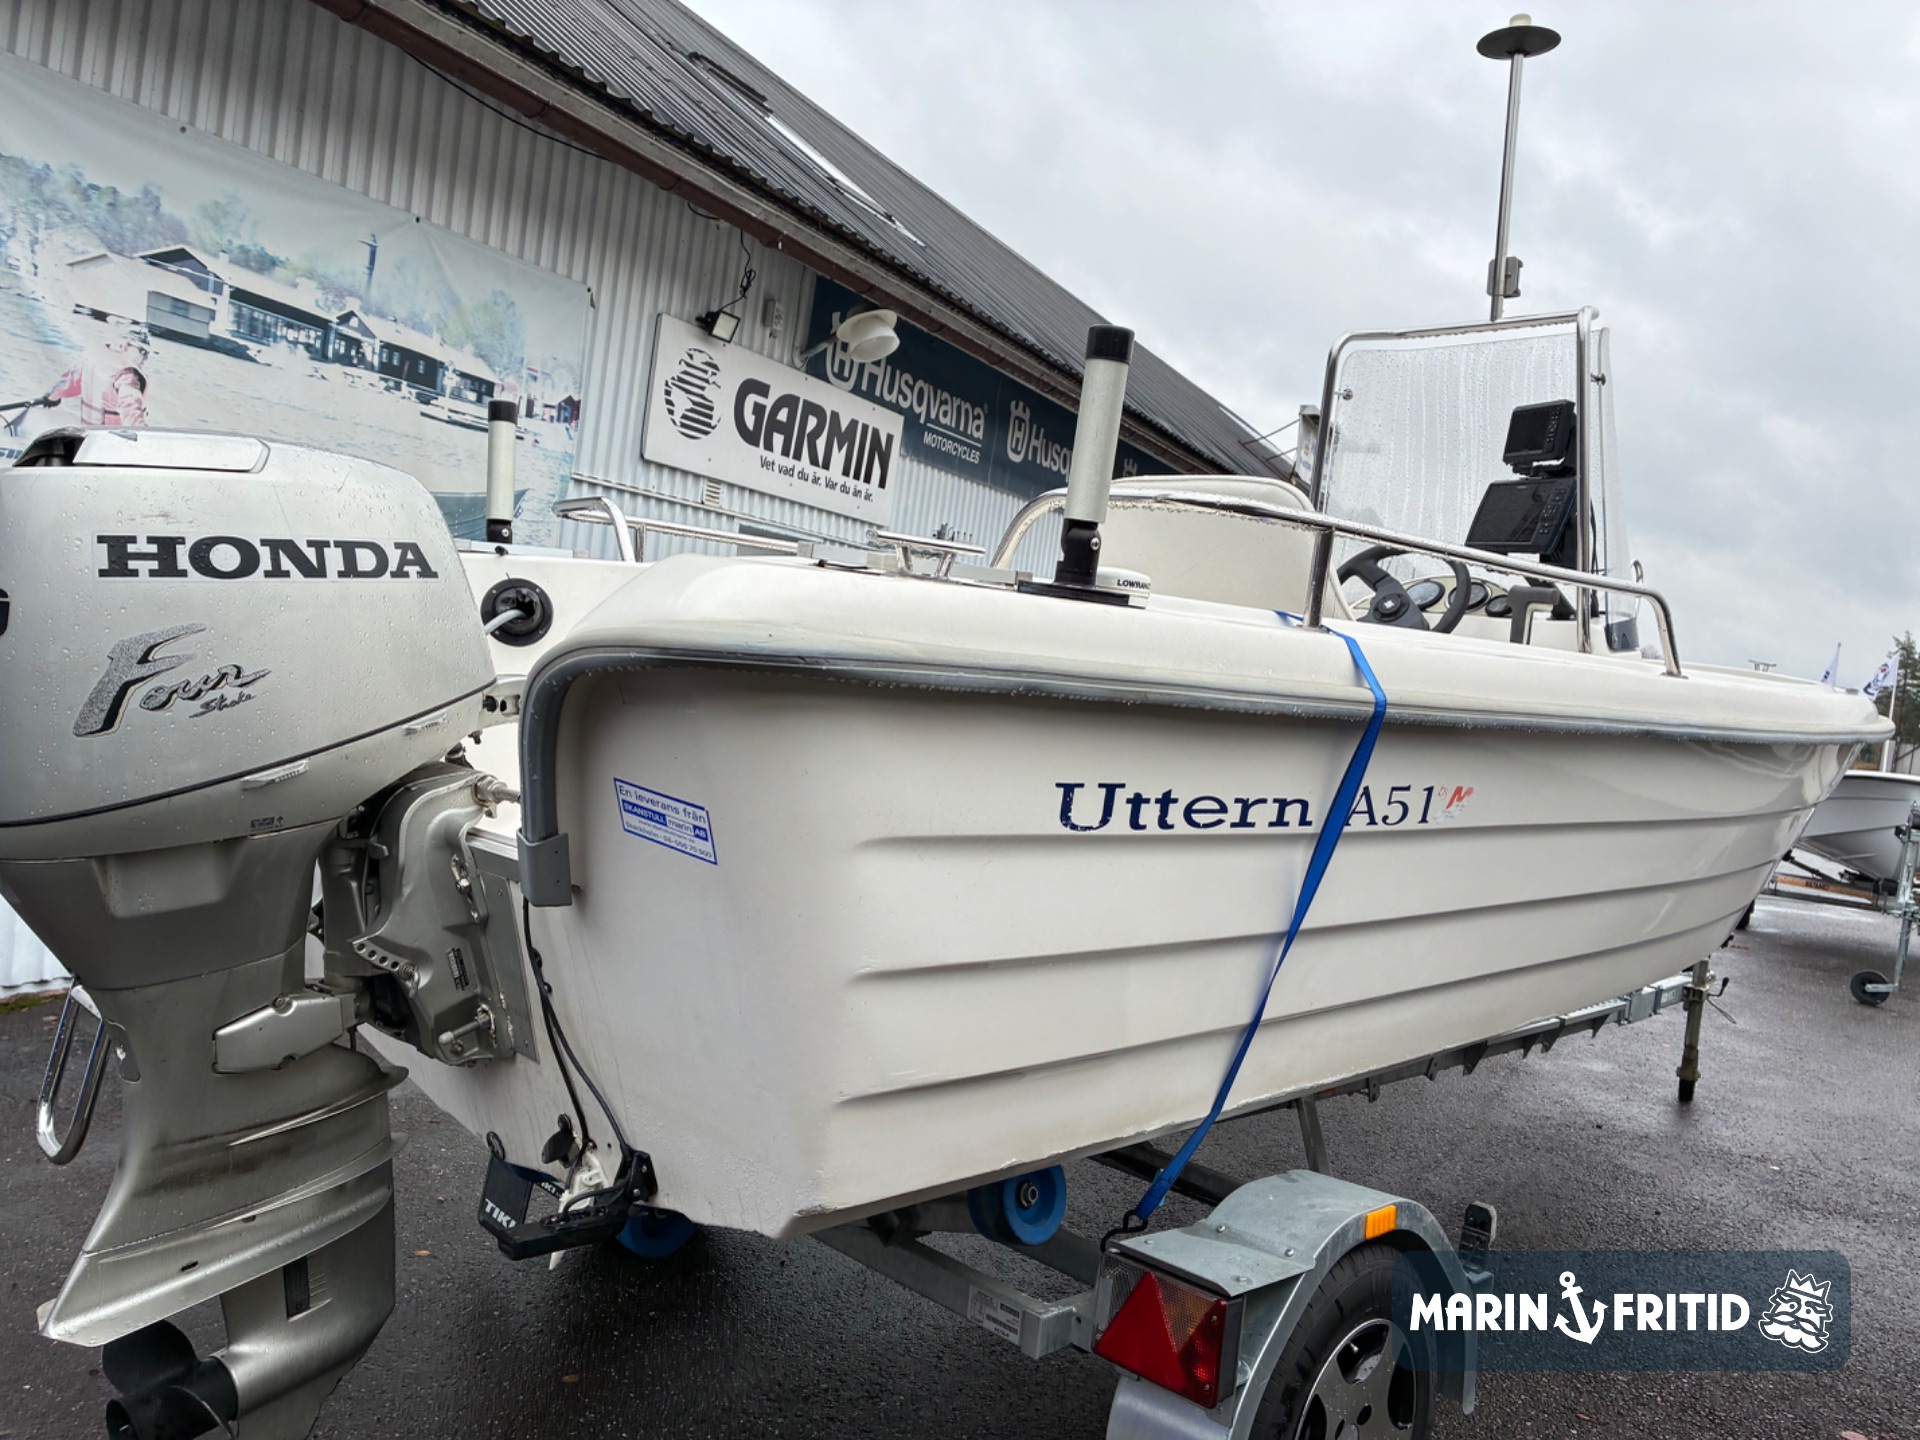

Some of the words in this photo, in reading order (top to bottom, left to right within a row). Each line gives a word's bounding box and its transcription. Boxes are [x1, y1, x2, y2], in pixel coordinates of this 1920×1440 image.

[861, 355, 985, 440] Husqvarna
[734, 377, 894, 490] GARMIN
[923, 431, 981, 464] MOTORCYCLES
[1028, 423, 1072, 483] Husq
[760, 455, 776, 473] Vet
[778, 462, 795, 478] vad
[797, 467, 809, 482] du
[824, 476, 838, 491] Var
[840, 481, 850, 496] du
[96, 534, 439, 579] HONDA
[1117, 578, 1151, 590] LOWRANC
[72, 622, 272, 738] Four
[189, 691, 257, 718] Stroke
[618, 784, 632, 798] En
[634, 790, 680, 815] leverans
[682, 807, 707, 824] från
[1055, 781, 1313, 832] Uttern
[1343, 784, 1435, 826] A51
[694, 829, 707, 838] AB
